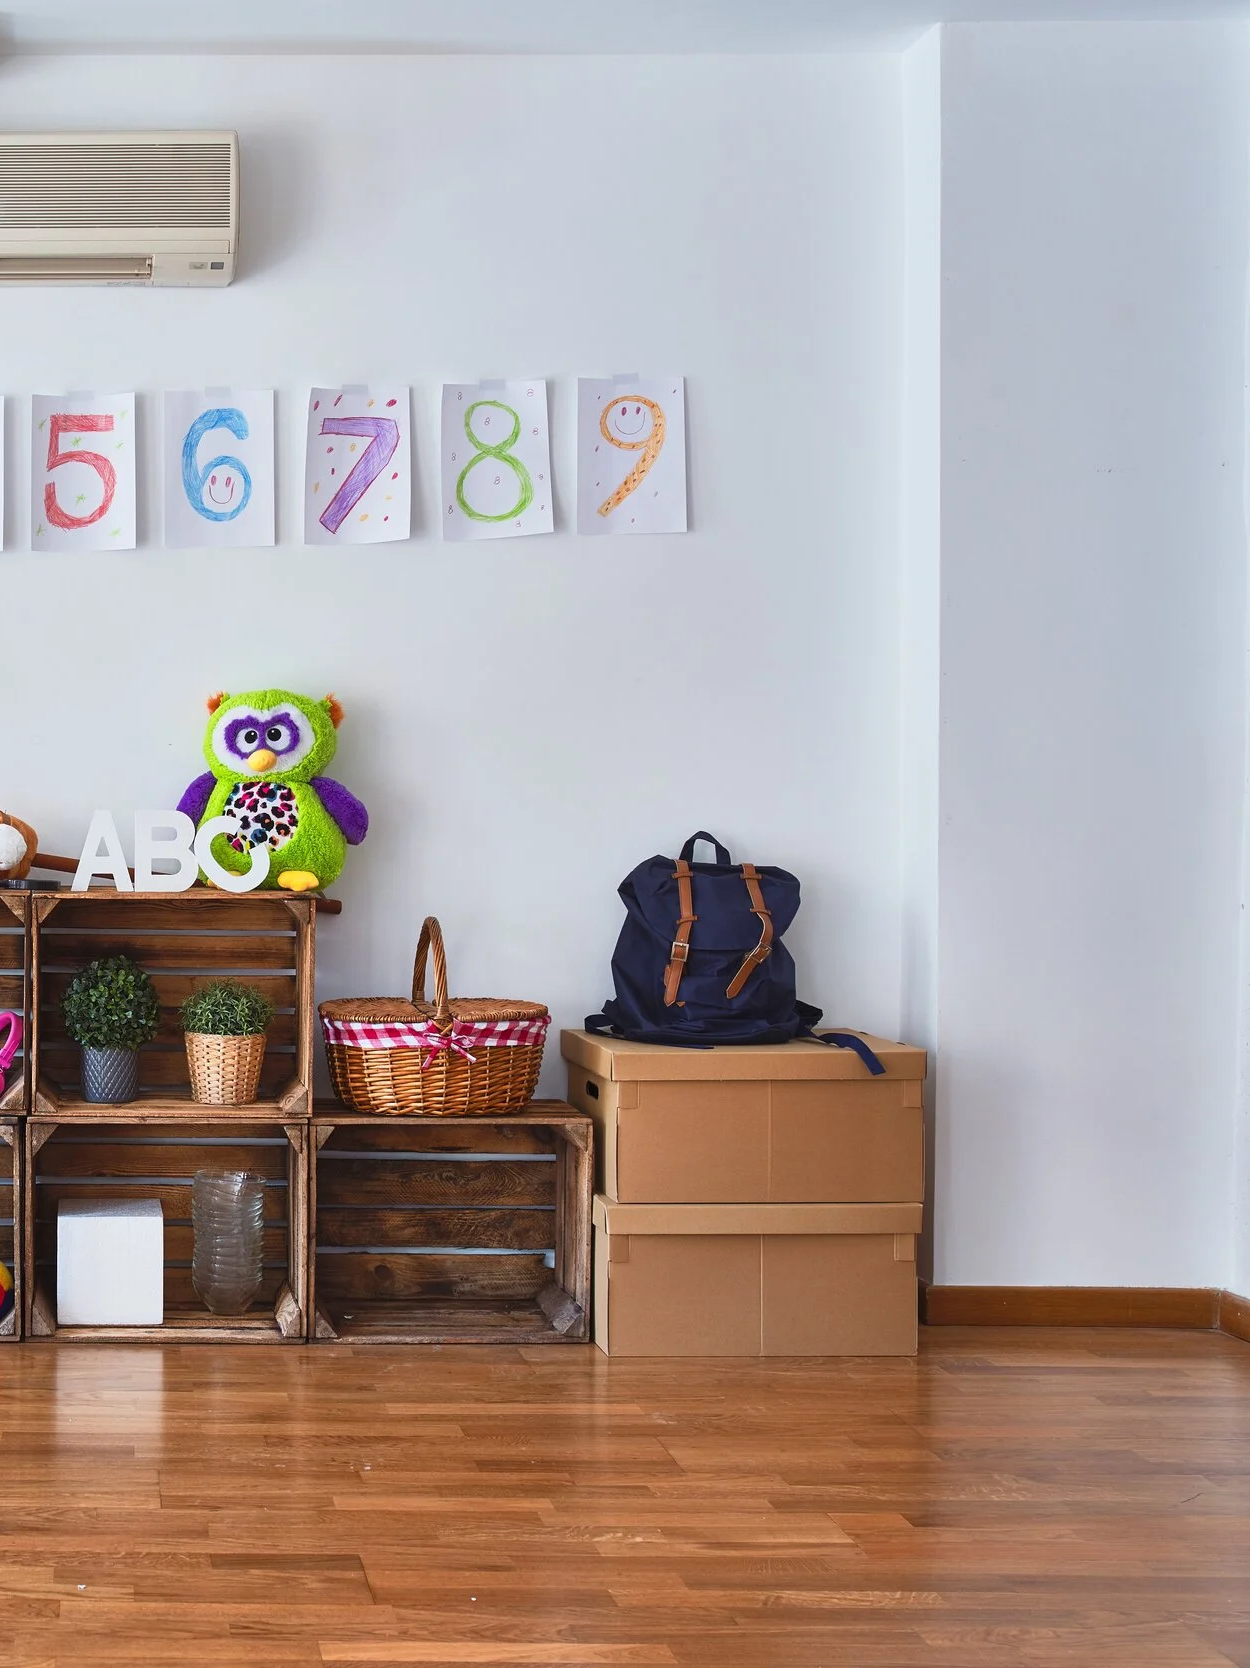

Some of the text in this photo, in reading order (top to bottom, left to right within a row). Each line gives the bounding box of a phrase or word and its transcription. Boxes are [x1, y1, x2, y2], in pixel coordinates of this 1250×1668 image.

[44, 414, 118, 530] 5
[181, 407, 253, 523] 6
[318, 416, 400, 535] 7
[456, 400, 534, 522] 8
[597, 395, 666, 517] 9
[70, 809, 271, 894] ABC
